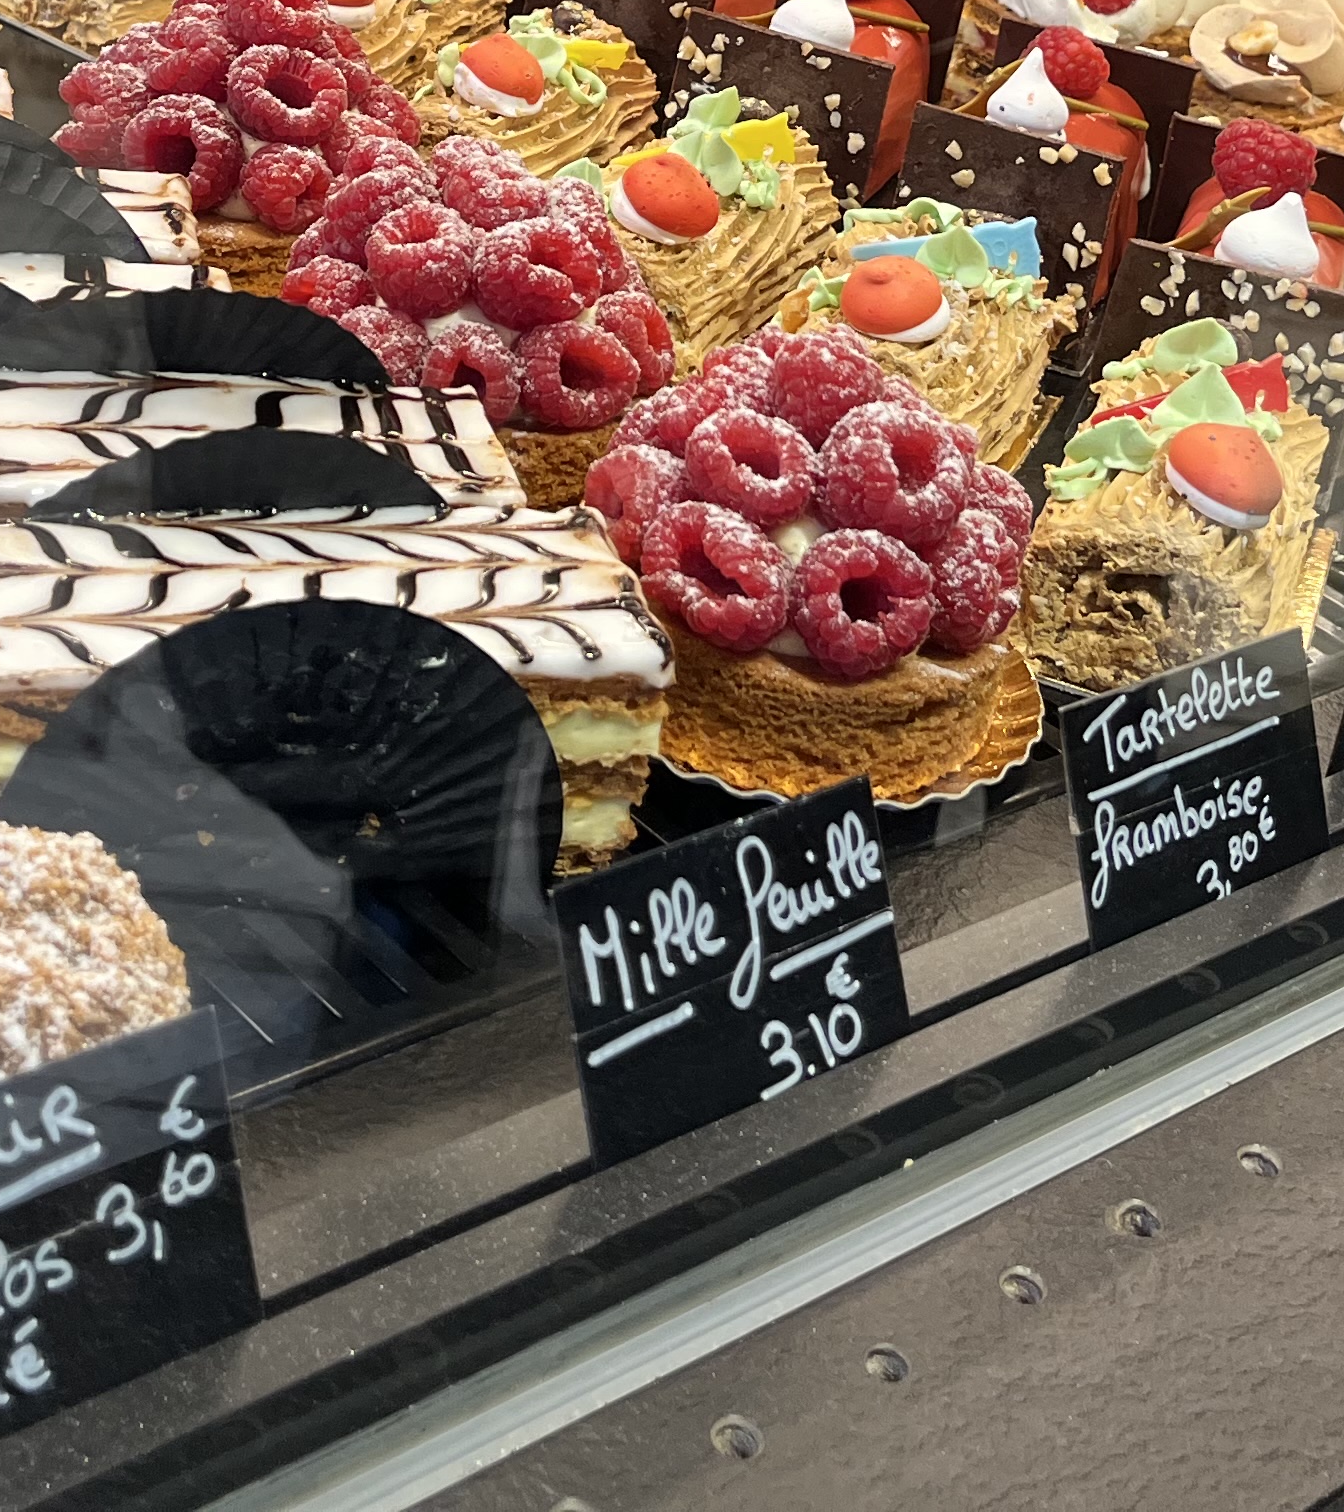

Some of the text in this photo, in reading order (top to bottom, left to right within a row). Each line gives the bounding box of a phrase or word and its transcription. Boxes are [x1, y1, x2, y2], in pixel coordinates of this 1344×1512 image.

[1082, 656, 1280, 774] Tartelette
[1090, 775, 1263, 909] framboise
[578, 809, 882, 1012] Mille feuille
